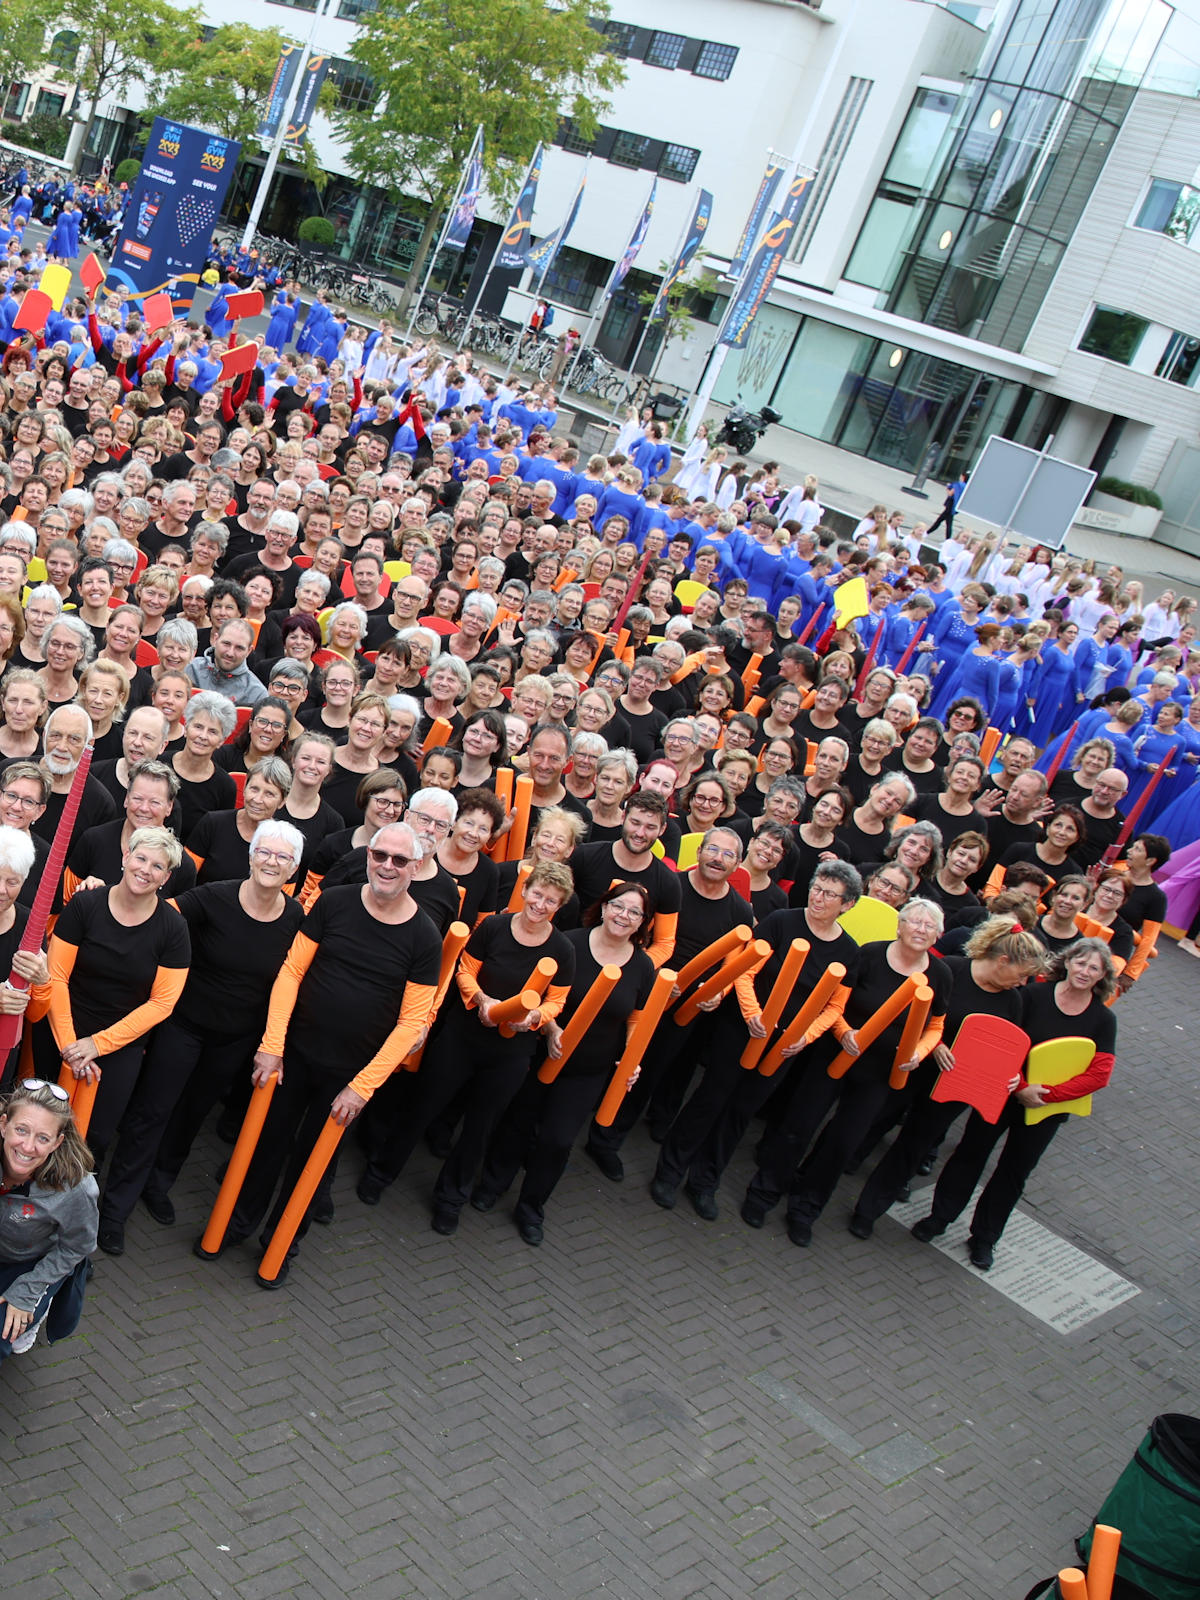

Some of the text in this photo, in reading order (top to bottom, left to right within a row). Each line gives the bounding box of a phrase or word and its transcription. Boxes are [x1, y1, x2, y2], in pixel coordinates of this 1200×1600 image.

[162, 132, 181, 144] GYM
[158, 139, 181, 156] 2023
[206, 145, 226, 157] GYM
[200, 153, 226, 170] 2023
[192, 178, 203, 188] SEE
